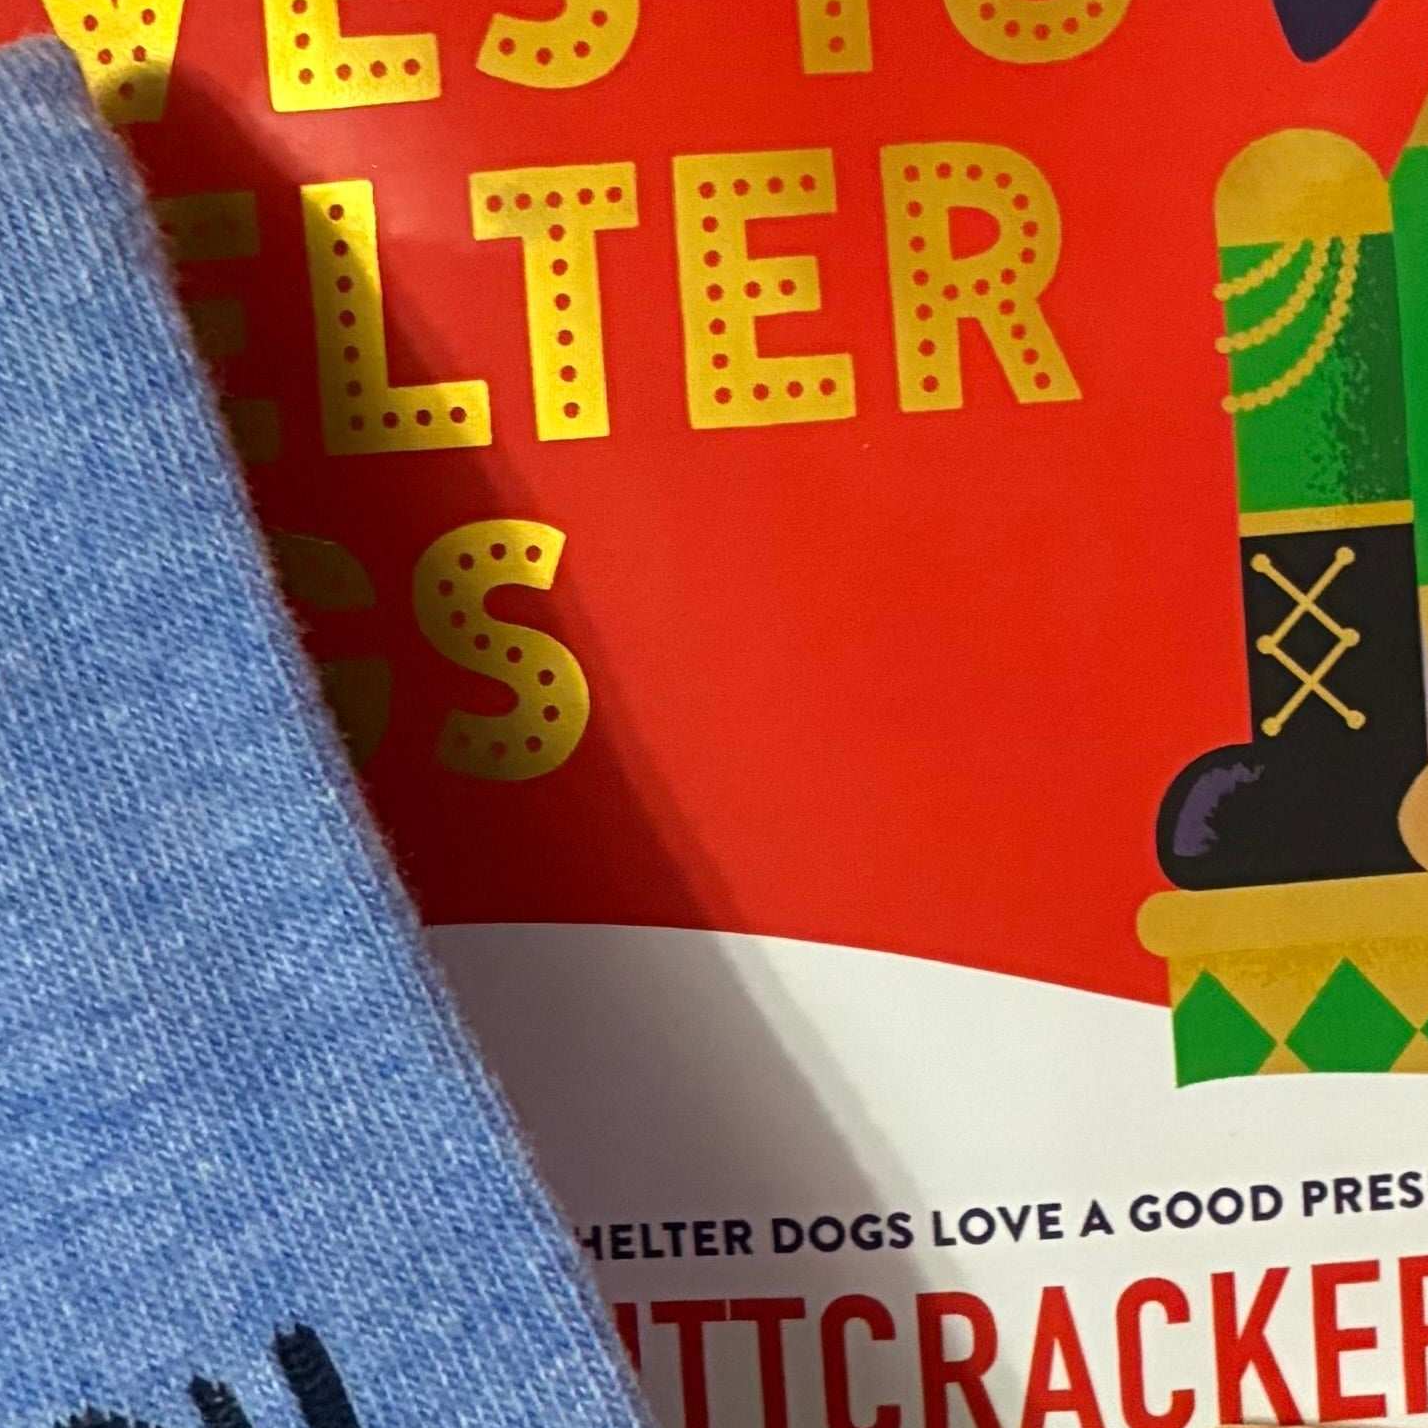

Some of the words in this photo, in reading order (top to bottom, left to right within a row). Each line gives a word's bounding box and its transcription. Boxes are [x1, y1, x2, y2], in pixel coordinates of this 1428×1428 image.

[772, 1211, 914, 1254] DOGS
[932, 1202, 1064, 1247] LOVE
[1080, 1199, 1115, 1237] A
[1129, 1183, 1283, 1233] GOOD
